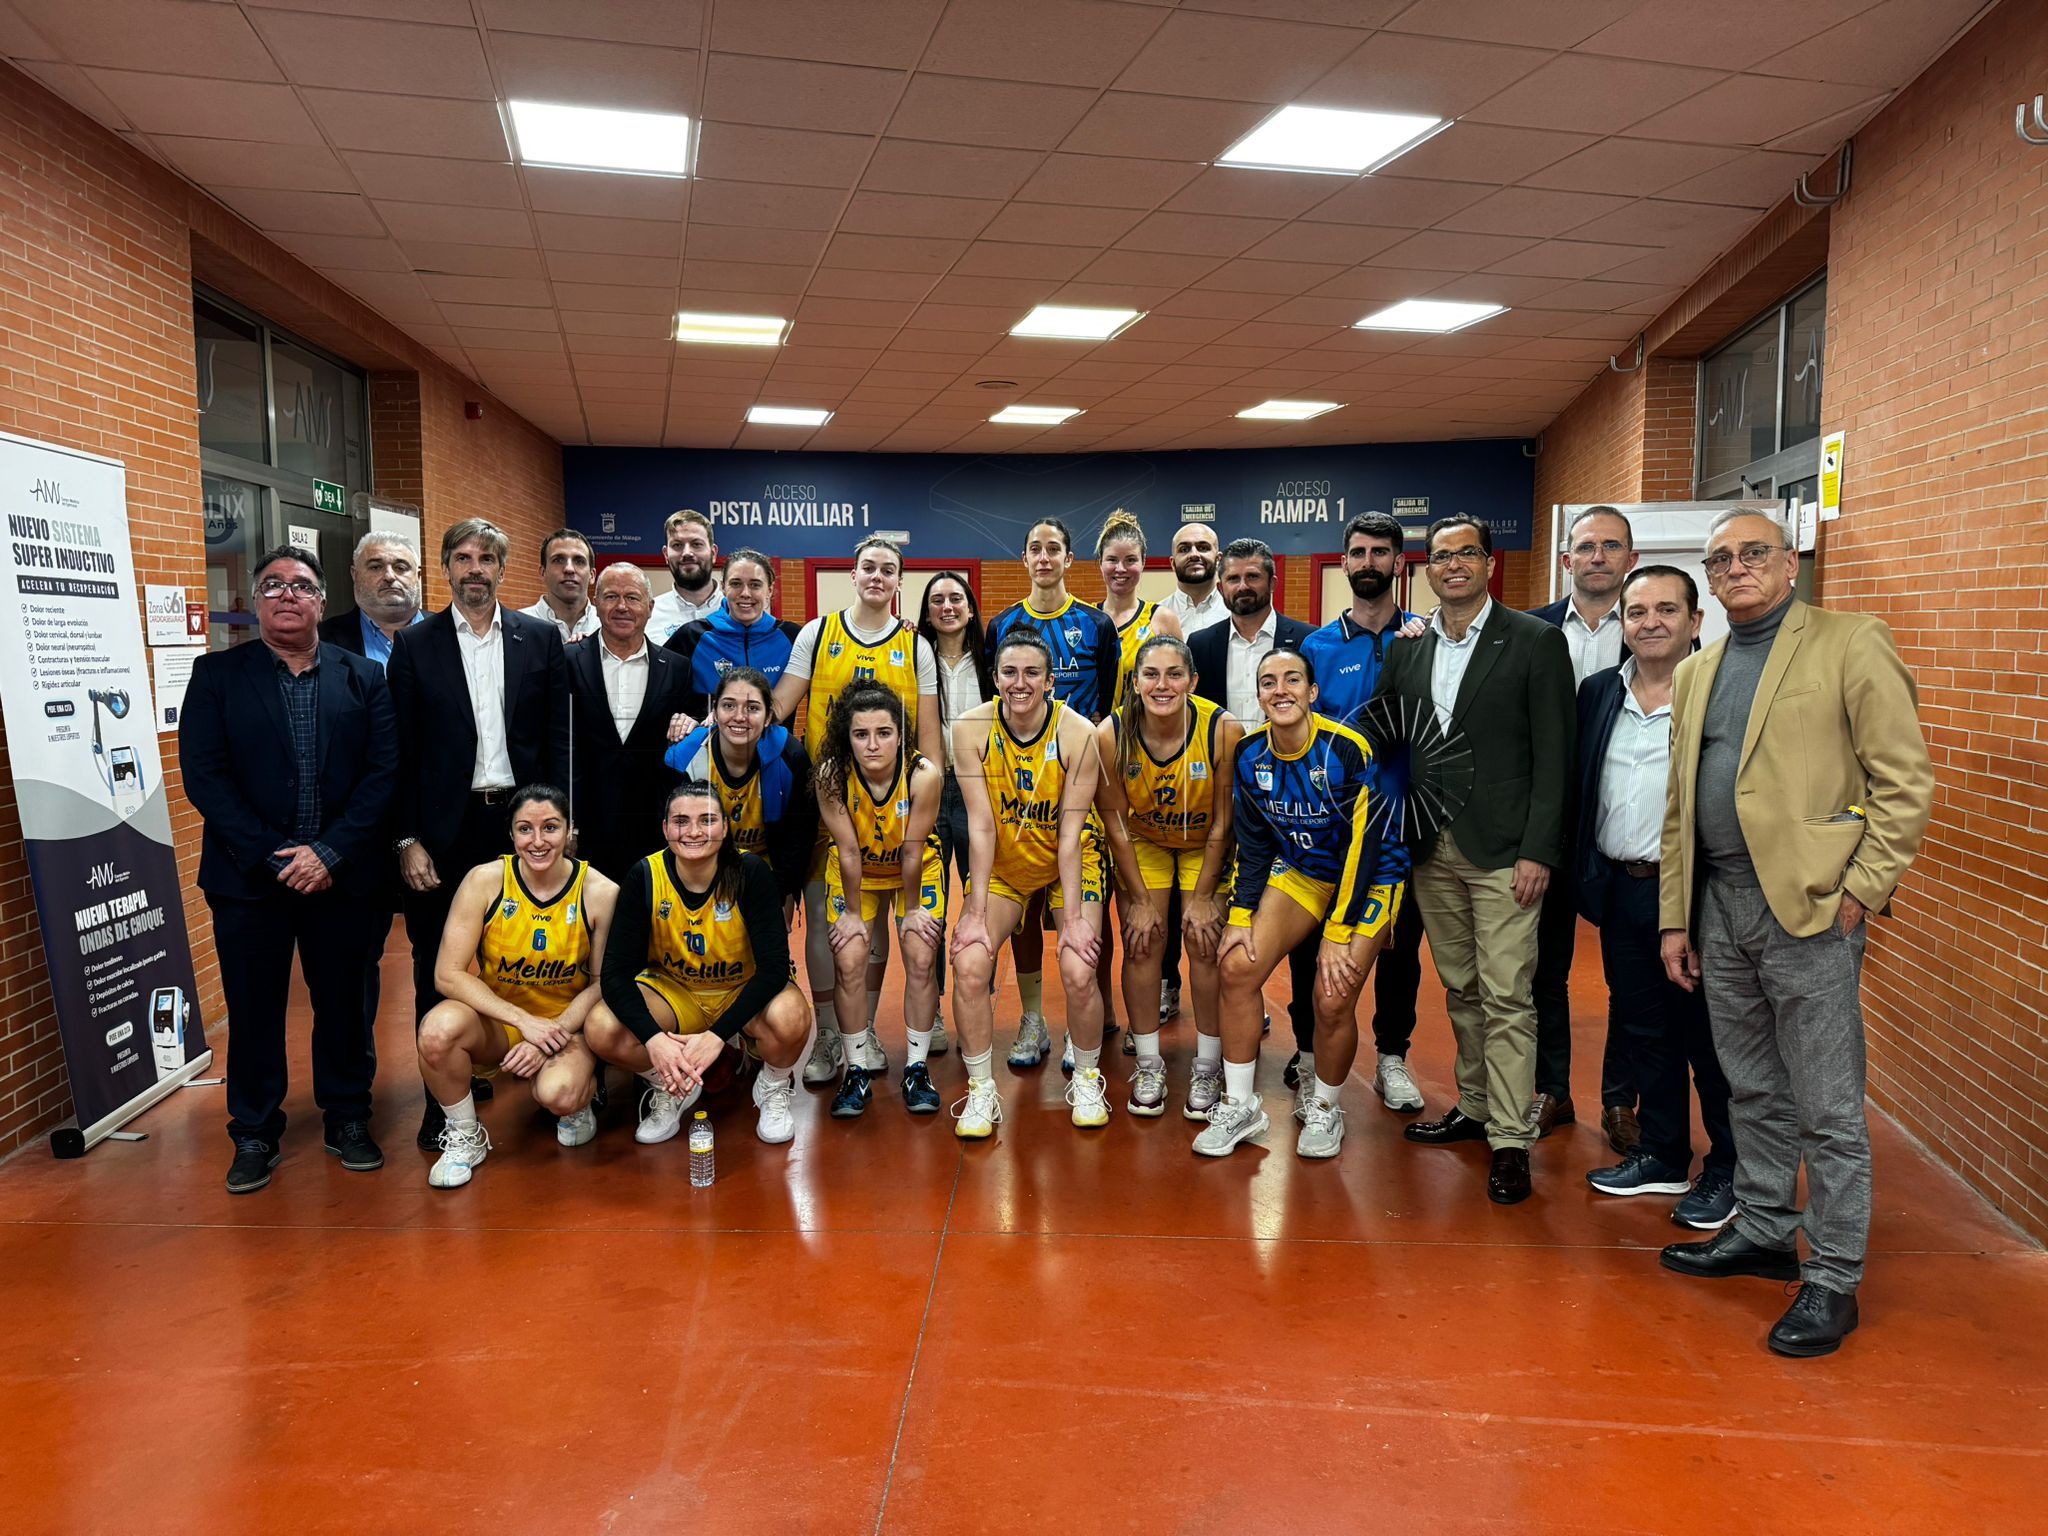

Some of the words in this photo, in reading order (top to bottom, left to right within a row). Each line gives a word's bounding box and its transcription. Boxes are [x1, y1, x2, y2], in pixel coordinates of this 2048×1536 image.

[764, 484, 816, 501] ACCESO
[1276, 480, 1331, 497] ACCESO
[1260, 498, 1329, 524] RAMPA
[1337, 497, 1345, 522] 1
[1393, 507, 1427, 515] EMERGENCIA
[1397, 499, 1416, 507] SALIDA
[208, 519, 238, 529] Años
[710, 501, 763, 526] PISTA
[768, 502, 853, 527] AUXILIAR
[860, 503, 869, 527] 1
[8, 513, 50, 541] NUEVO
[51, 520, 102, 547] SISTEMA
[292, 531, 303, 544] SALA
[303, 533, 309, 544] 2
[12, 542, 54, 569] SUPER
[54, 547, 115, 574] INDUCTIVO
[21, 578, 53, 591] ACELERA
[56, 581, 65, 592] TU
[68, 582, 116, 595] RECUPERACIÓN
[149, 601, 163, 614] Zona
[163, 592, 184, 614] 061
[856, 654, 875, 662] vive
[1339, 663, 1361, 674] vive
[1014, 767, 1034, 791] 18
[1155, 773, 1176, 781] vive
[1154, 786, 1176, 806] 12
[1264, 797, 1330, 817] MELILLA
[1289, 831, 1314, 849] 10
[921, 885, 937, 910] 5
[75, 902, 109, 932] NUEVA
[108, 889, 149, 919] TERAPIA
[532, 914, 552, 922] vive
[80, 925, 114, 956] ONDAS
[114, 920, 130, 942] DE
[130, 906, 165, 936] CHOQUE
[532, 928, 547, 952] 6
[498, 956, 577, 979] Melilla
